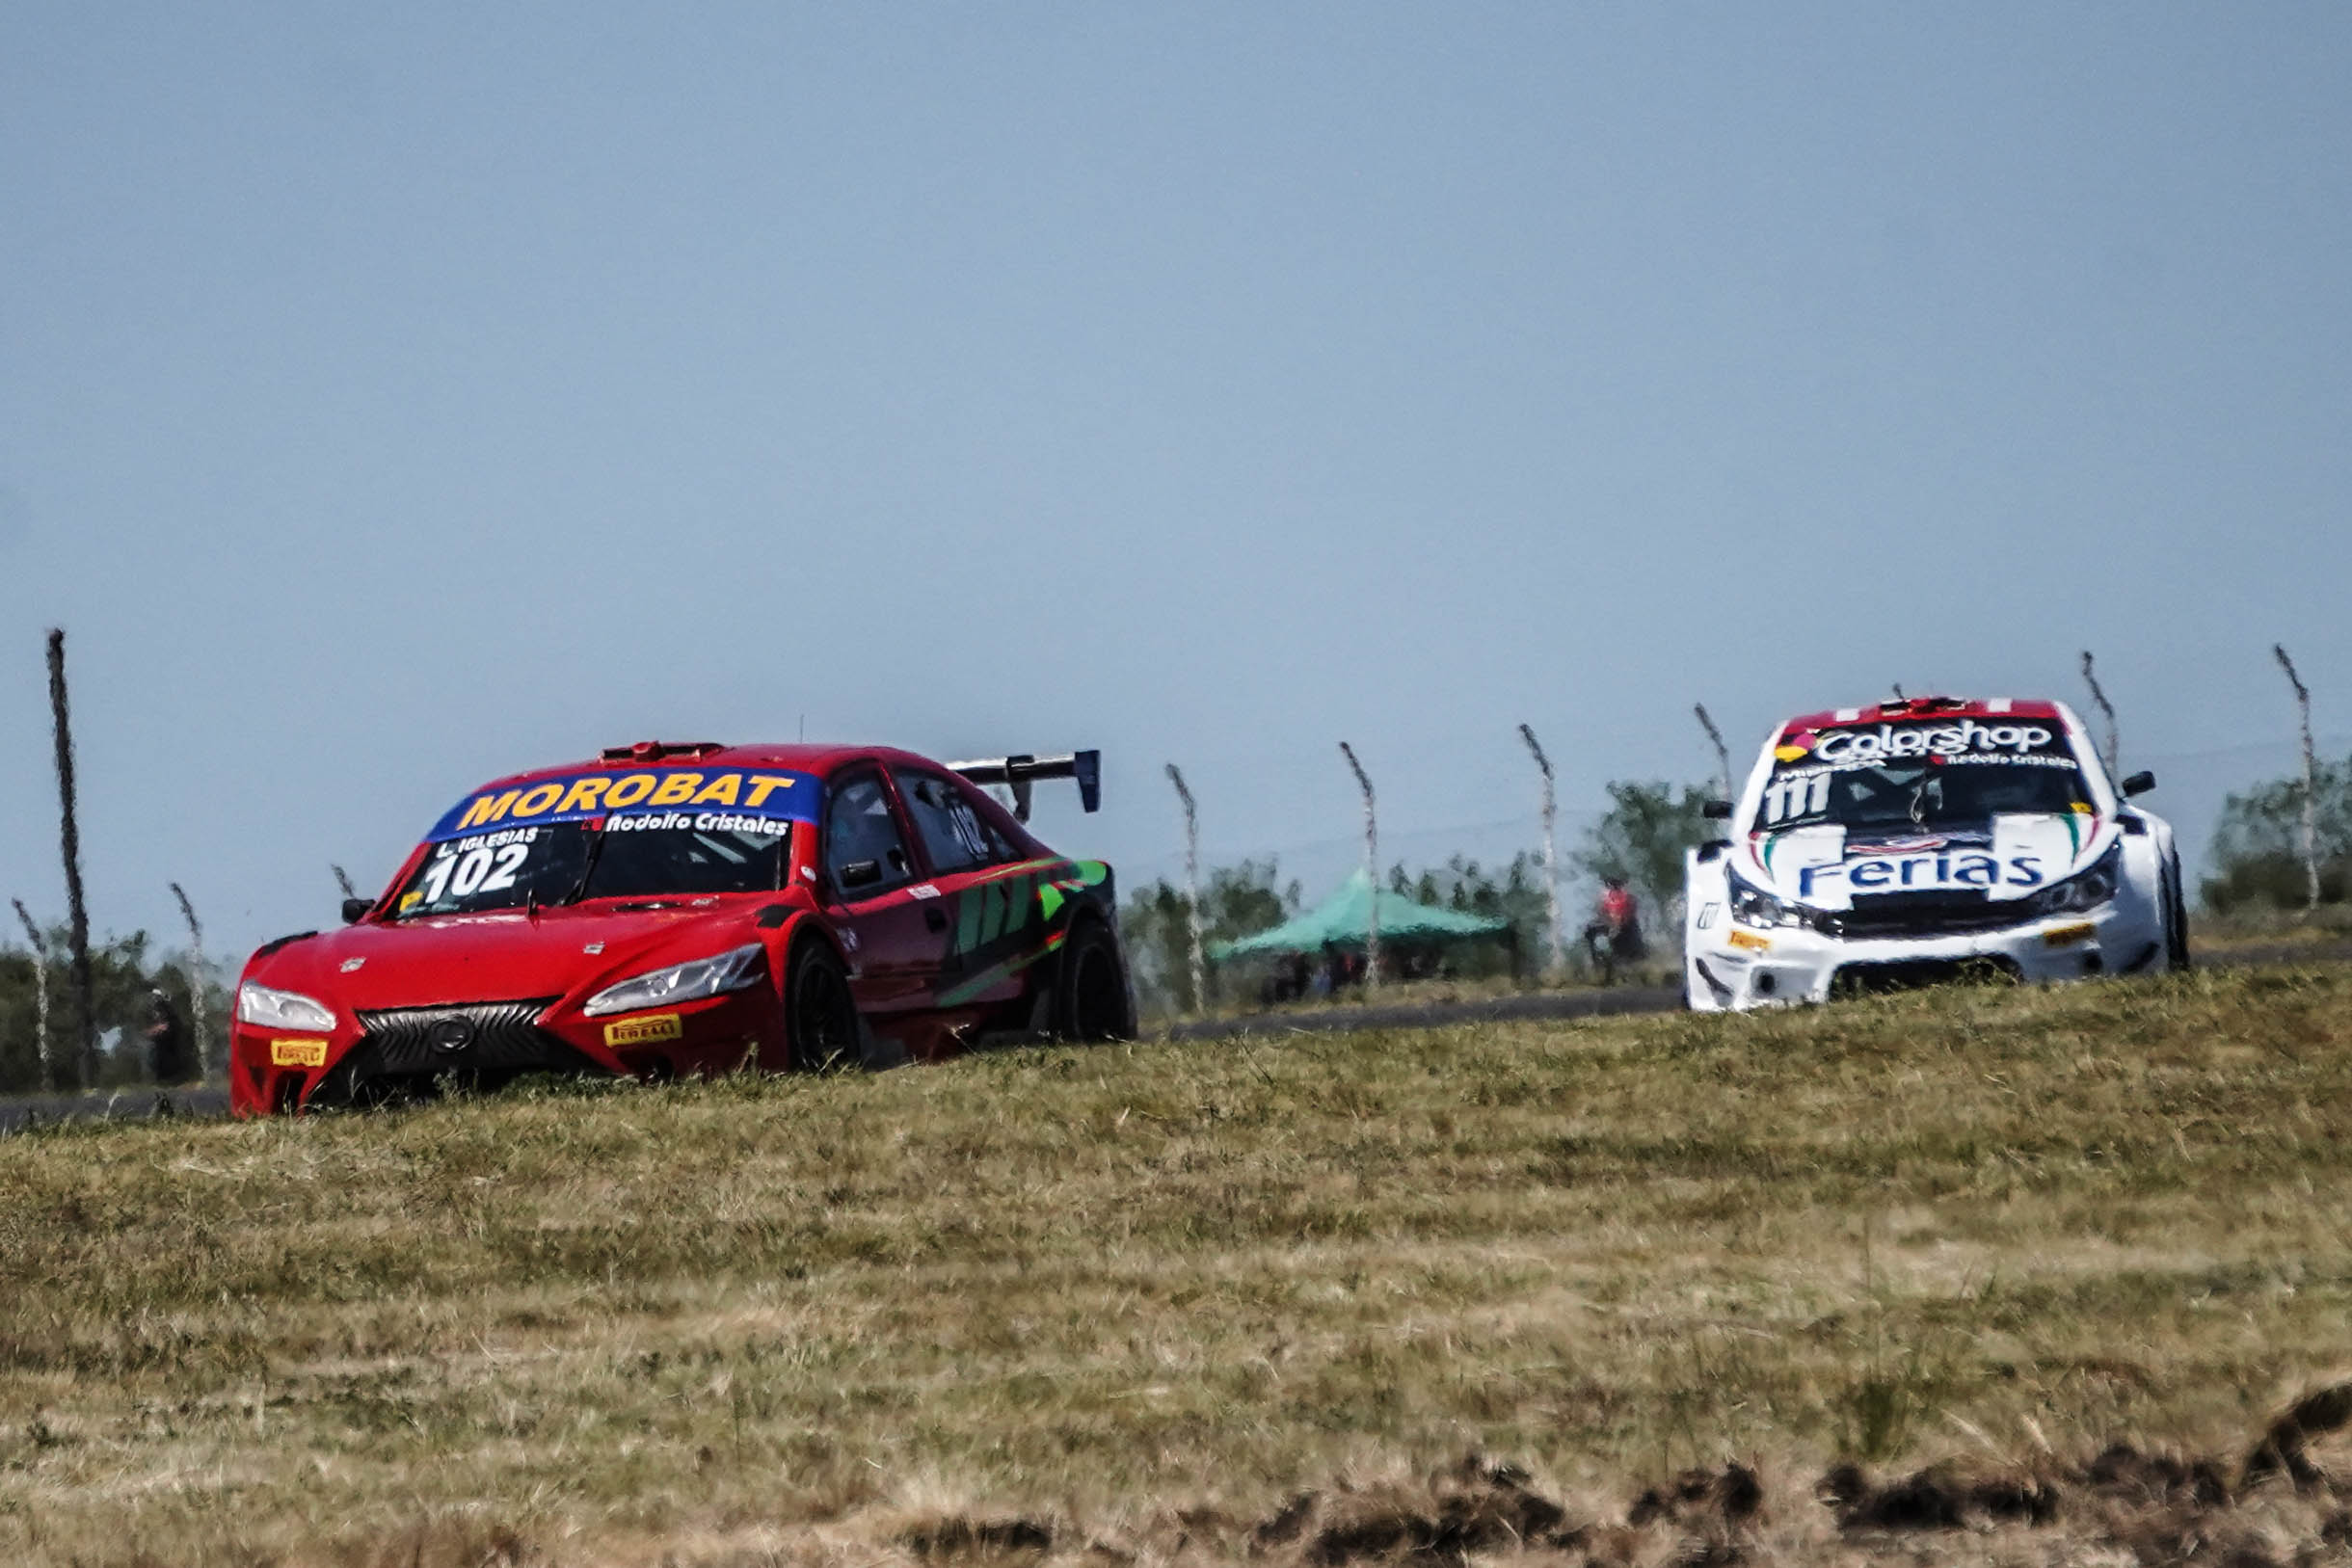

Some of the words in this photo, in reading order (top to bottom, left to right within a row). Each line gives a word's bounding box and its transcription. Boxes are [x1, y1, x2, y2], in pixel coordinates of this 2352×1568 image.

[1817, 718, 2052, 760] Colorshop
[455, 774, 795, 830] MOROBAT
[1765, 771, 1831, 824] 111
[458, 827, 539, 853] IGLESIAS
[605, 812, 691, 832] Rodolfo
[694, 812, 789, 836] Cristales
[425, 843, 528, 903] 102
[1800, 852, 2044, 899] Ferias
